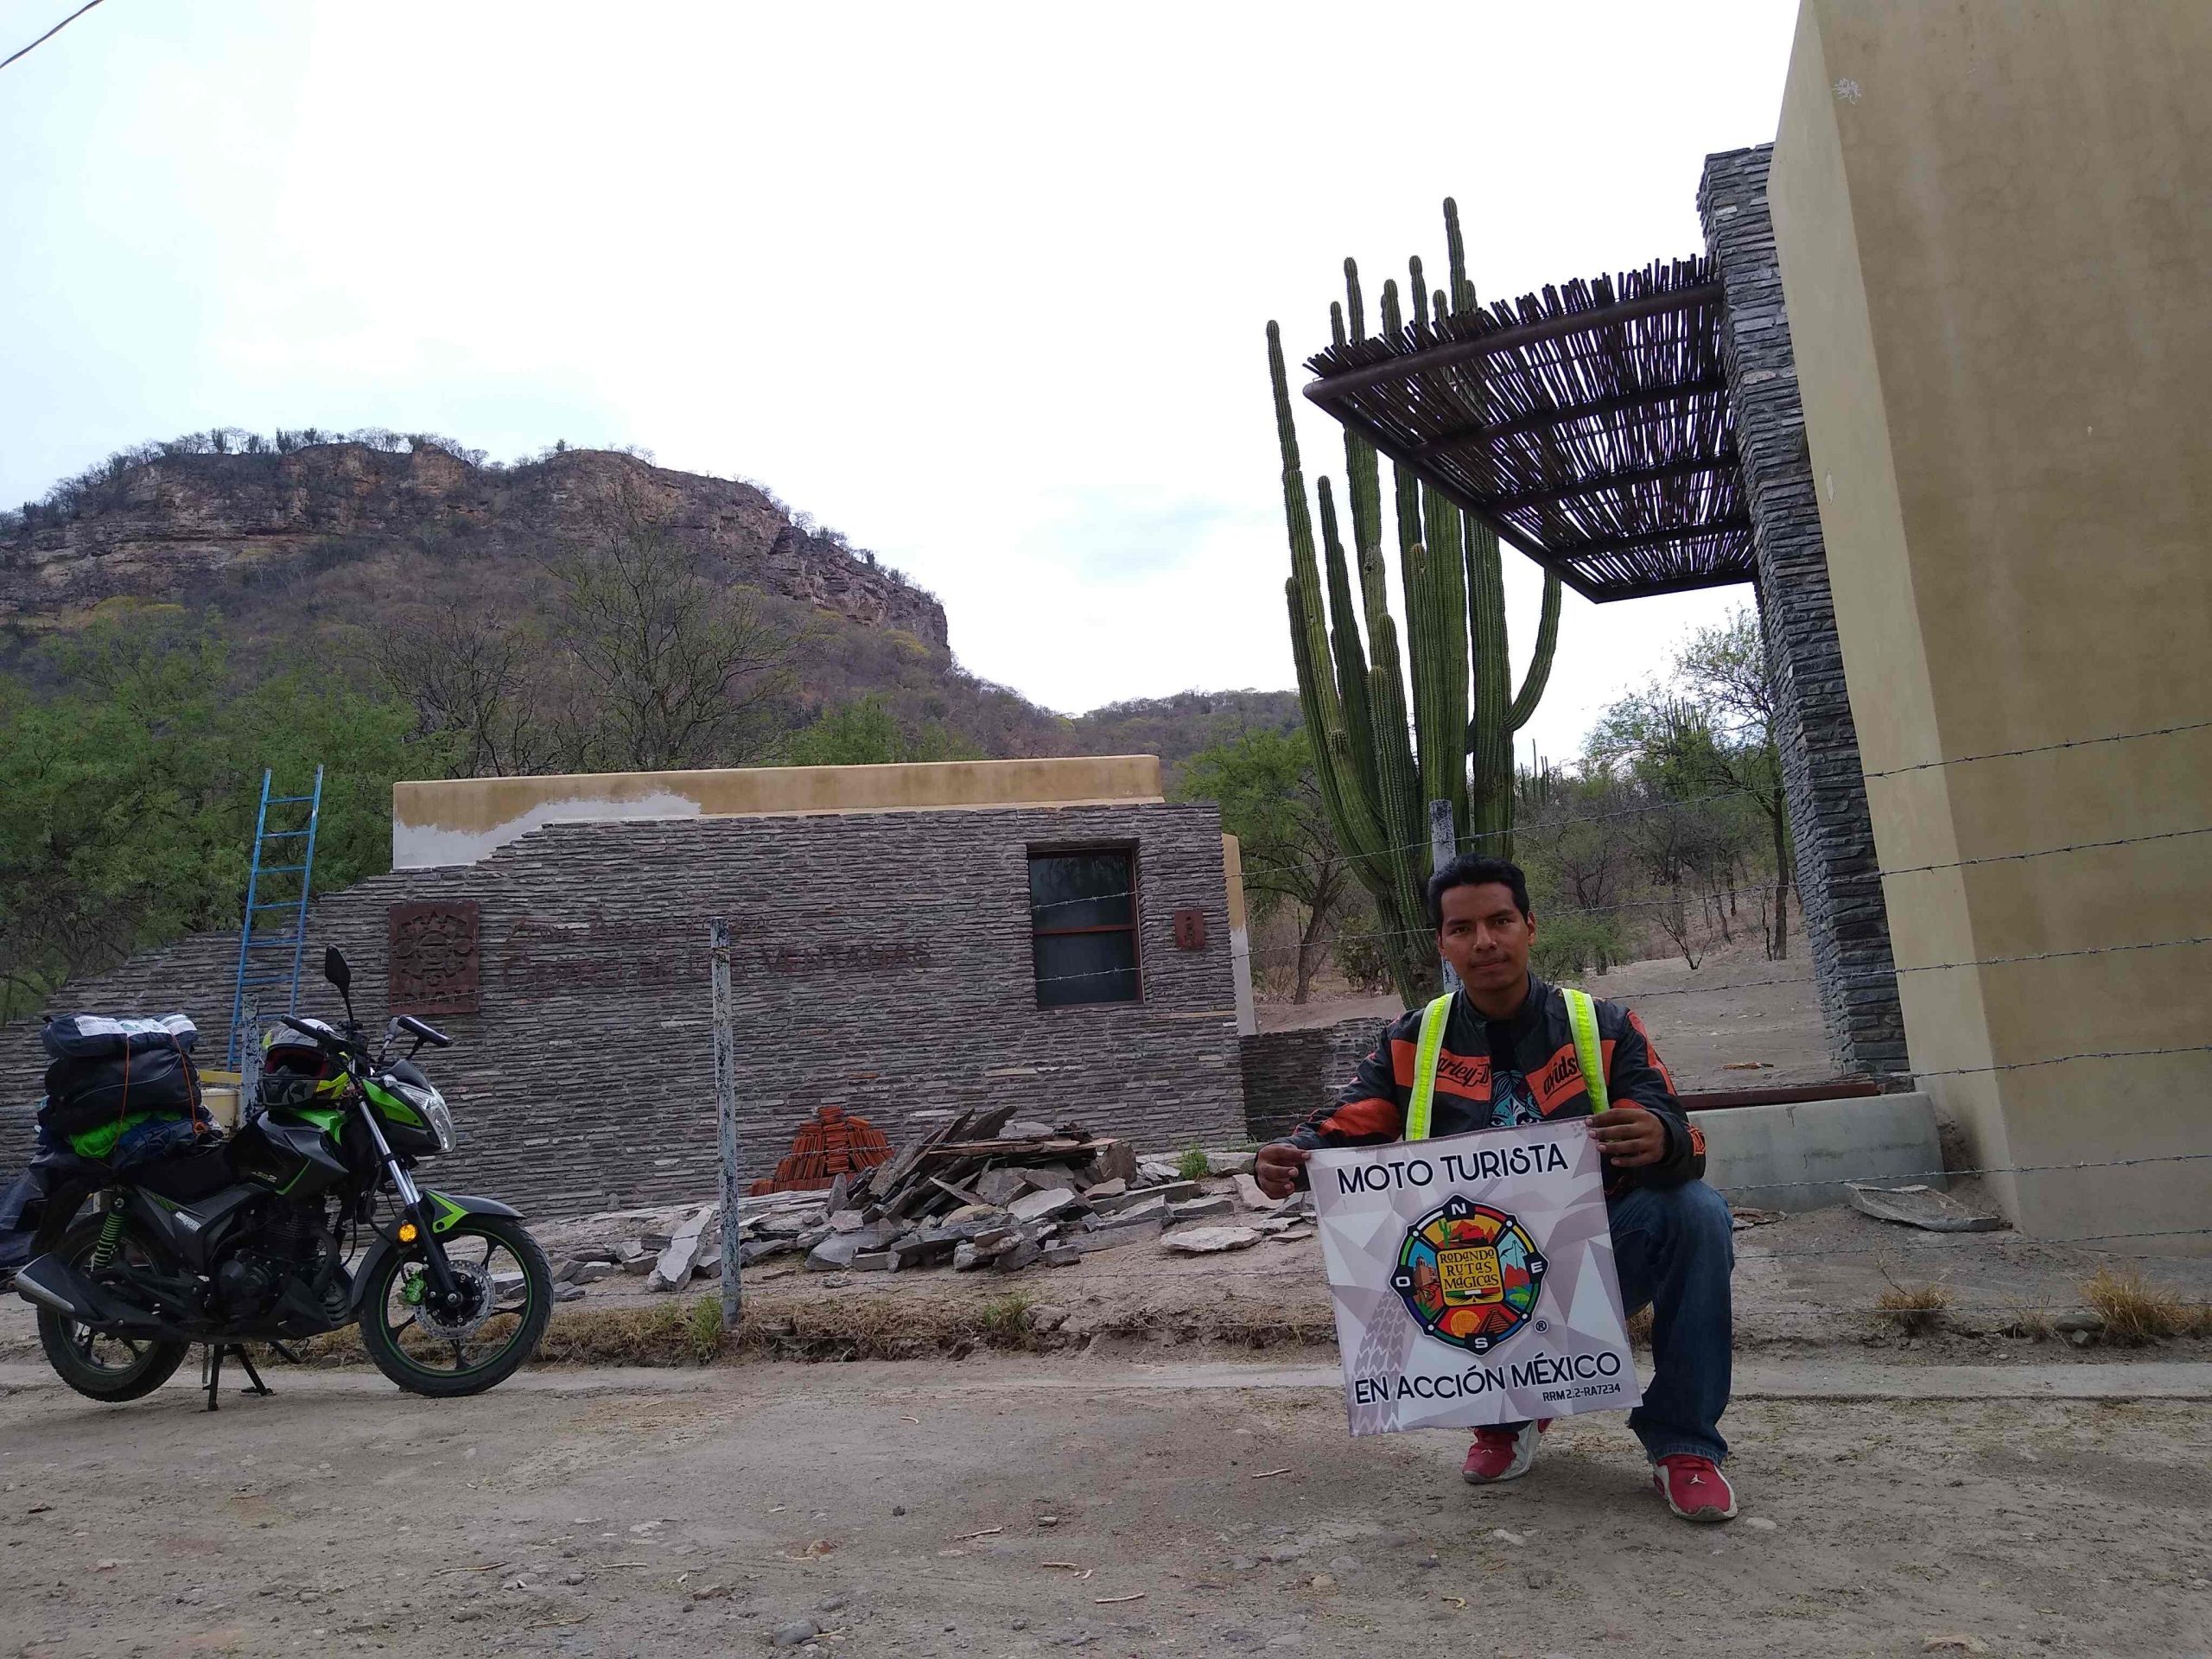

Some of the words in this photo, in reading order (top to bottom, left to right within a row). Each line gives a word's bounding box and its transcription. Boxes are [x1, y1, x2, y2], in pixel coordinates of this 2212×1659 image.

[1437, 1057, 1491, 1087] arley-D
[1543, 1055, 1578, 1095] avids
[1338, 1160, 1433, 1194] MOTO
[1440, 1143, 1568, 1181] TURISTA
[1452, 1203, 1467, 1215] N
[1530, 1261, 1543, 1273] E
[1475, 1337, 1489, 1350] S
[1355, 1378, 1389, 1404] EN
[1396, 1365, 1505, 1399] ACCIÓN
[1511, 1352, 1621, 1389] MÉXICO
